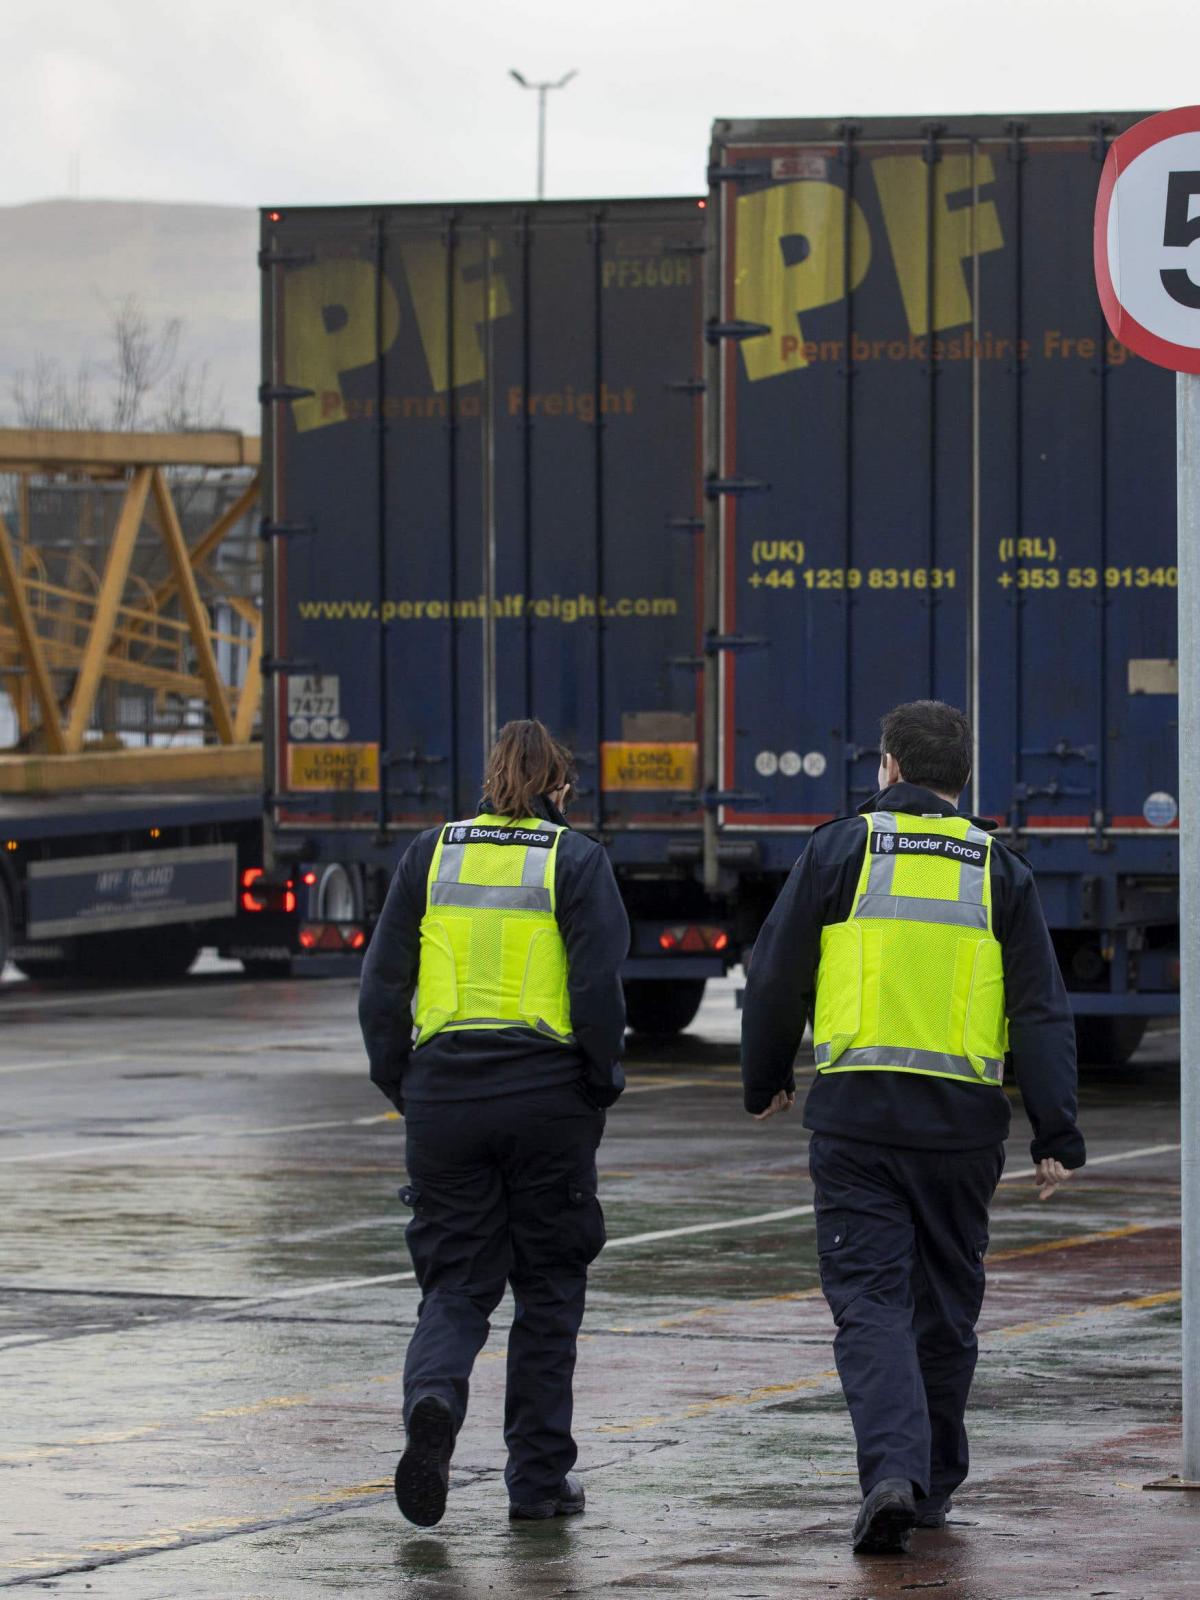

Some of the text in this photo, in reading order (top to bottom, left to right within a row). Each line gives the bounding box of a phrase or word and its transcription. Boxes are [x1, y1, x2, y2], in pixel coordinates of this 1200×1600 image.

[734, 153, 1005, 381] PF
[507, 384, 636, 421] Freight
[752, 540, 804, 564] (UK)
[999, 537, 1056, 561] (IRL)
[748, 568, 956, 589] +44 1239 831631
[997, 567, 1060, 590] +353
[1067, 567, 1097, 588] 53
[314, 752, 358, 765] LONG
[627, 751, 672, 765] LONG
[304, 767, 369, 781] VEHICLE
[618, 766, 683, 781] VEHICLE
[469, 827, 549, 843] Border Force
[897, 835, 981, 860] Border Force
